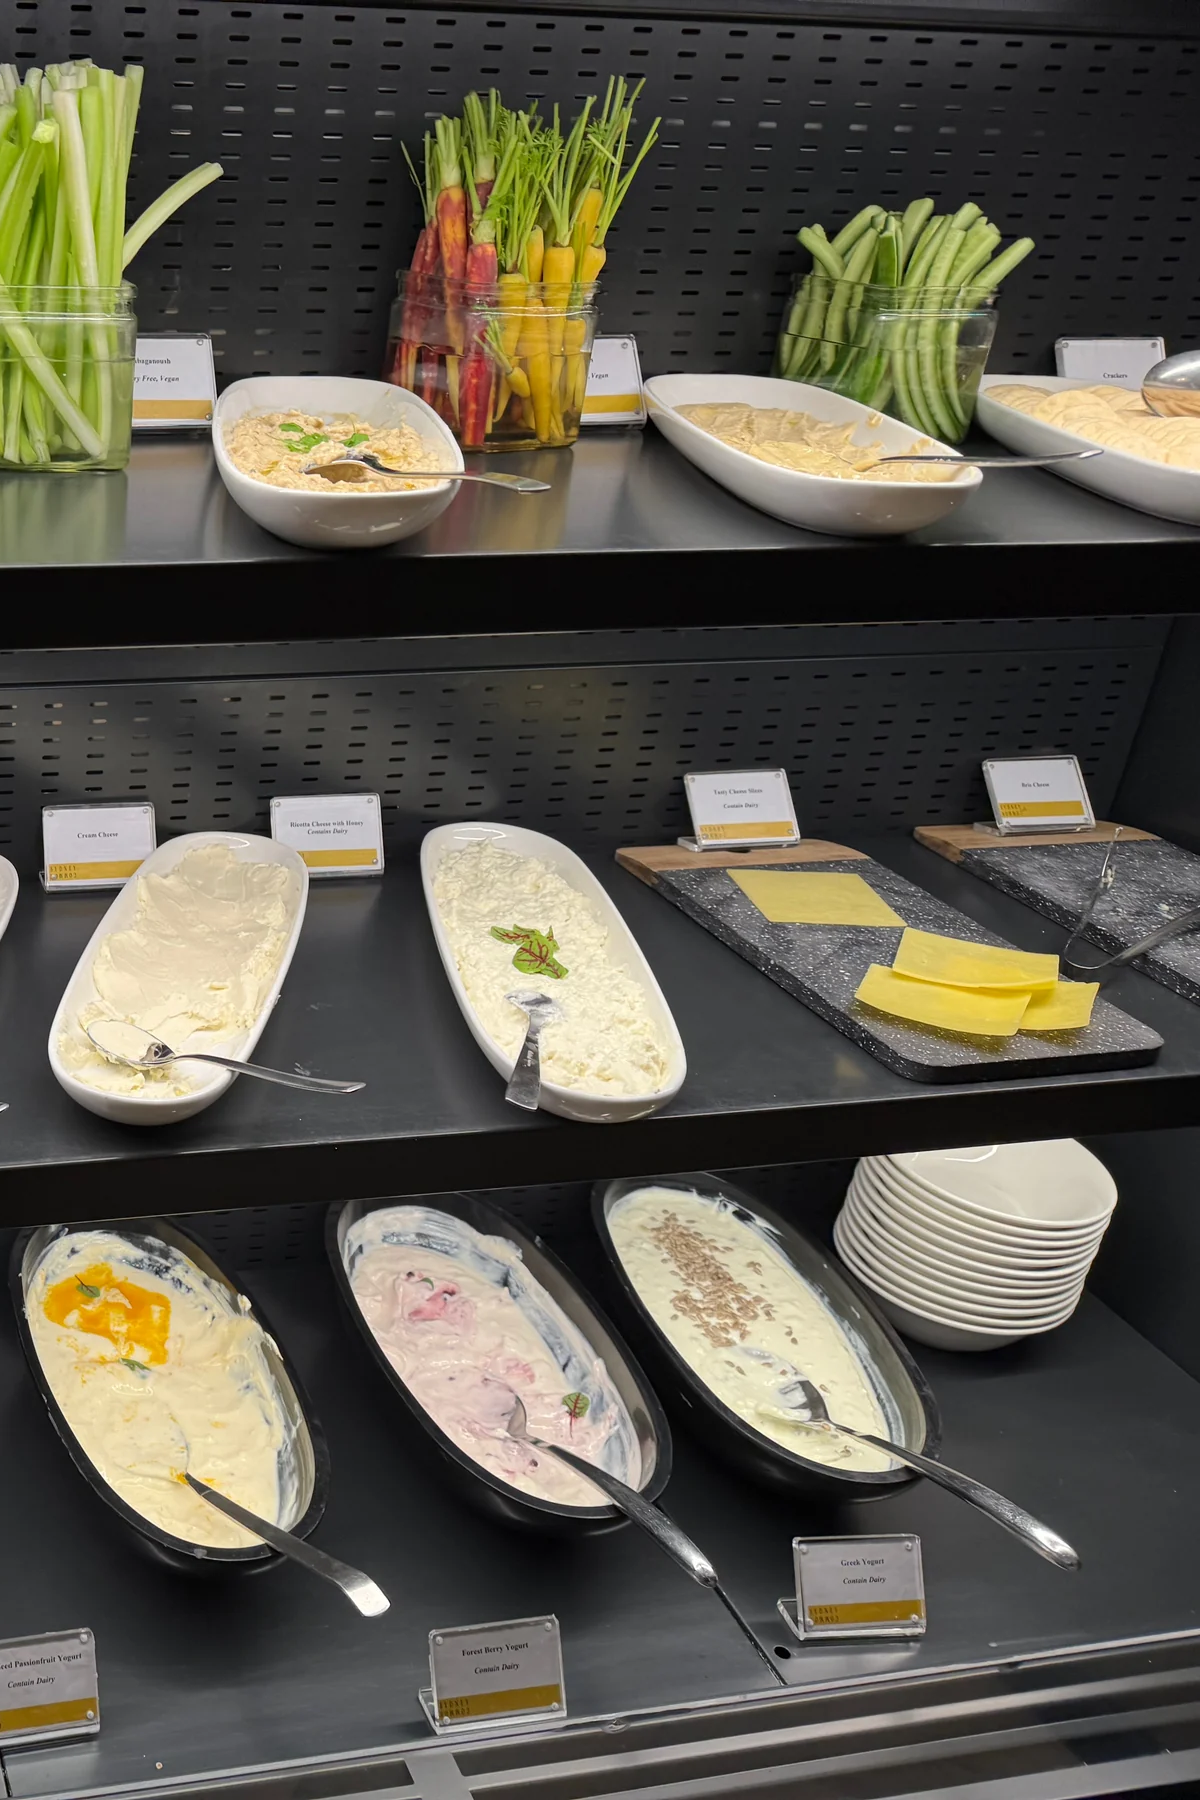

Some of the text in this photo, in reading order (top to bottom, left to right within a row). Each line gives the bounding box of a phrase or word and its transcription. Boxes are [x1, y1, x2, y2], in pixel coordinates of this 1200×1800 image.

[160, 375, 180, 383] Vegan
[840, 1558, 885, 1567] Greek Yogurt
[842, 1575, 887, 1585] Contain Dairy
[461, 1642, 529, 1656] Forest Berry Yogurt
[14, 1656, 56, 1668] Passionfruit
[57, 1653, 82, 1662] Yogurt
[474, 1662, 520, 1674] Contain Dairy
[7, 1676, 56, 1689] Contain Dairy
